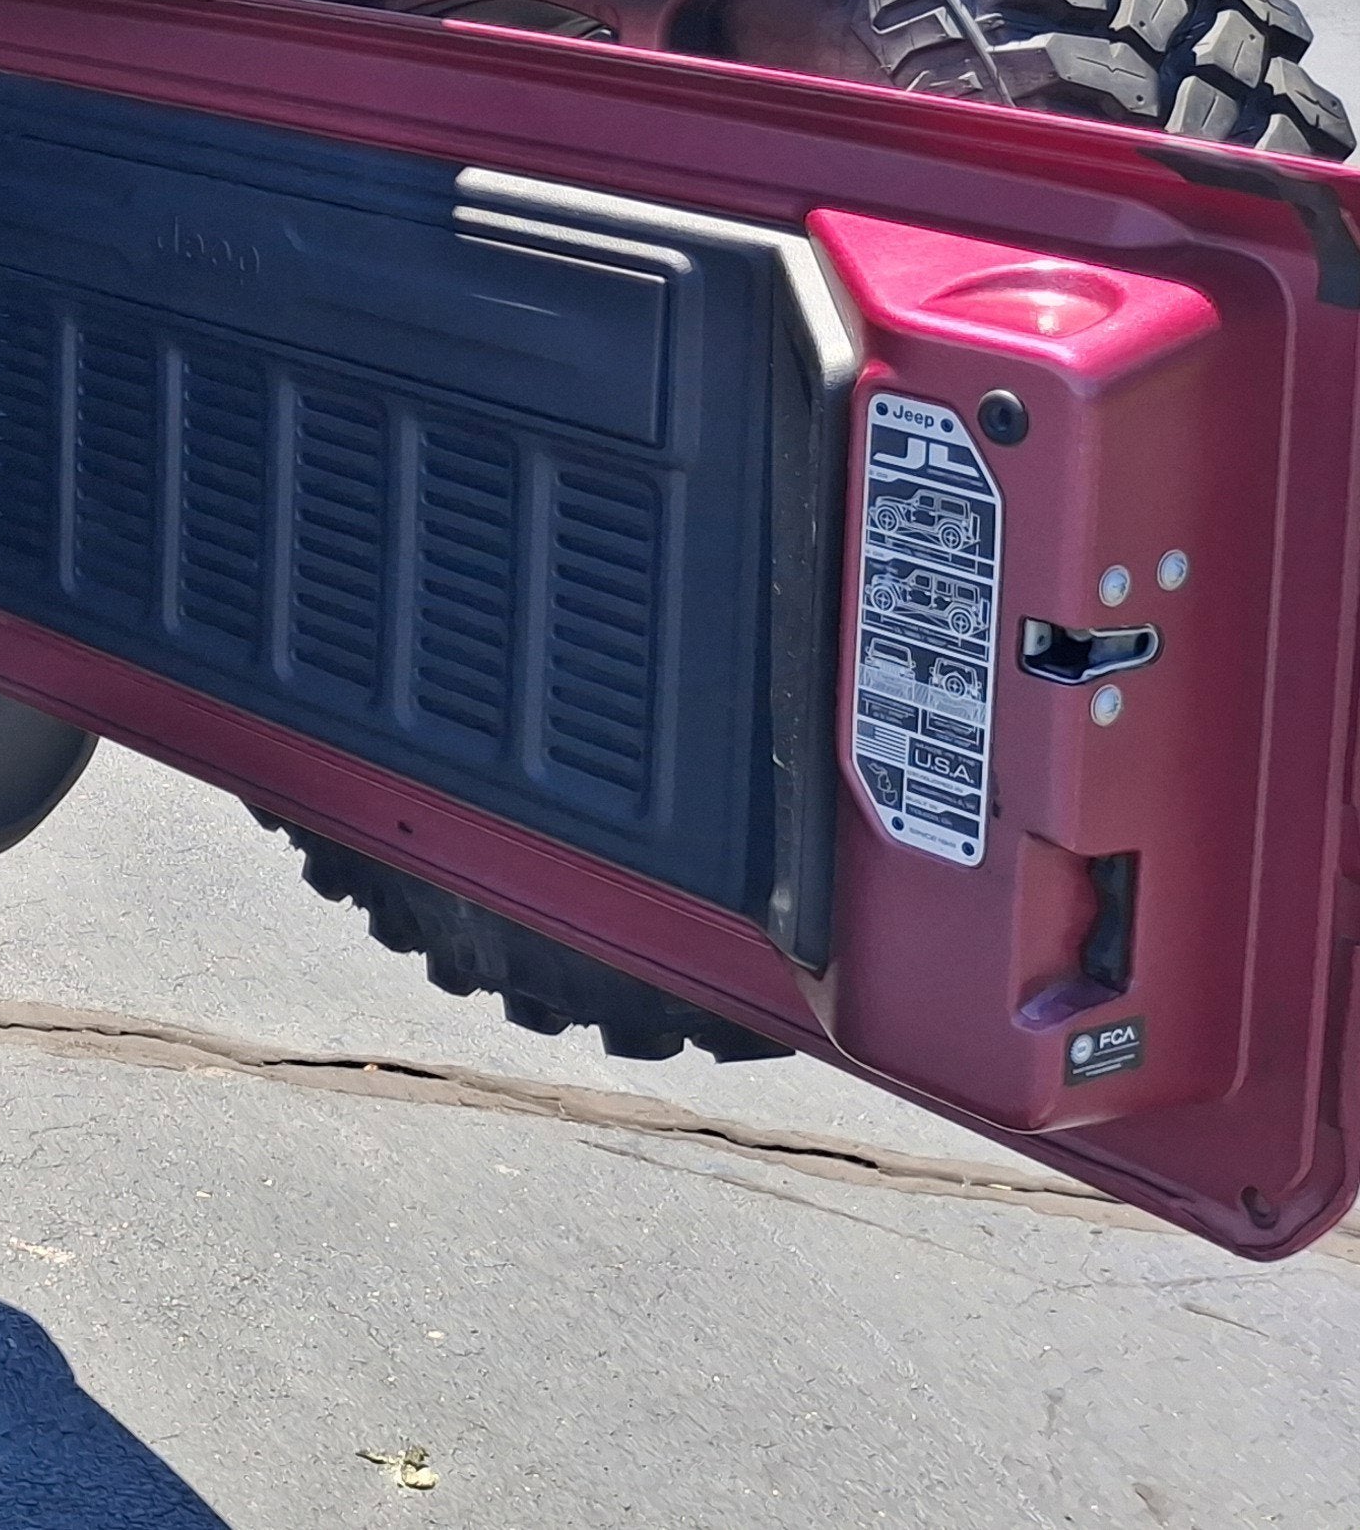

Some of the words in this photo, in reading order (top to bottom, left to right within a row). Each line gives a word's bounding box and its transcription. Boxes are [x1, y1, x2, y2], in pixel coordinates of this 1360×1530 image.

[893, 405, 935, 429] Jeep
[872, 437, 981, 478] JL
[915, 749, 975, 784] U.S.A.
[1099, 1025, 1136, 1049] FCA
